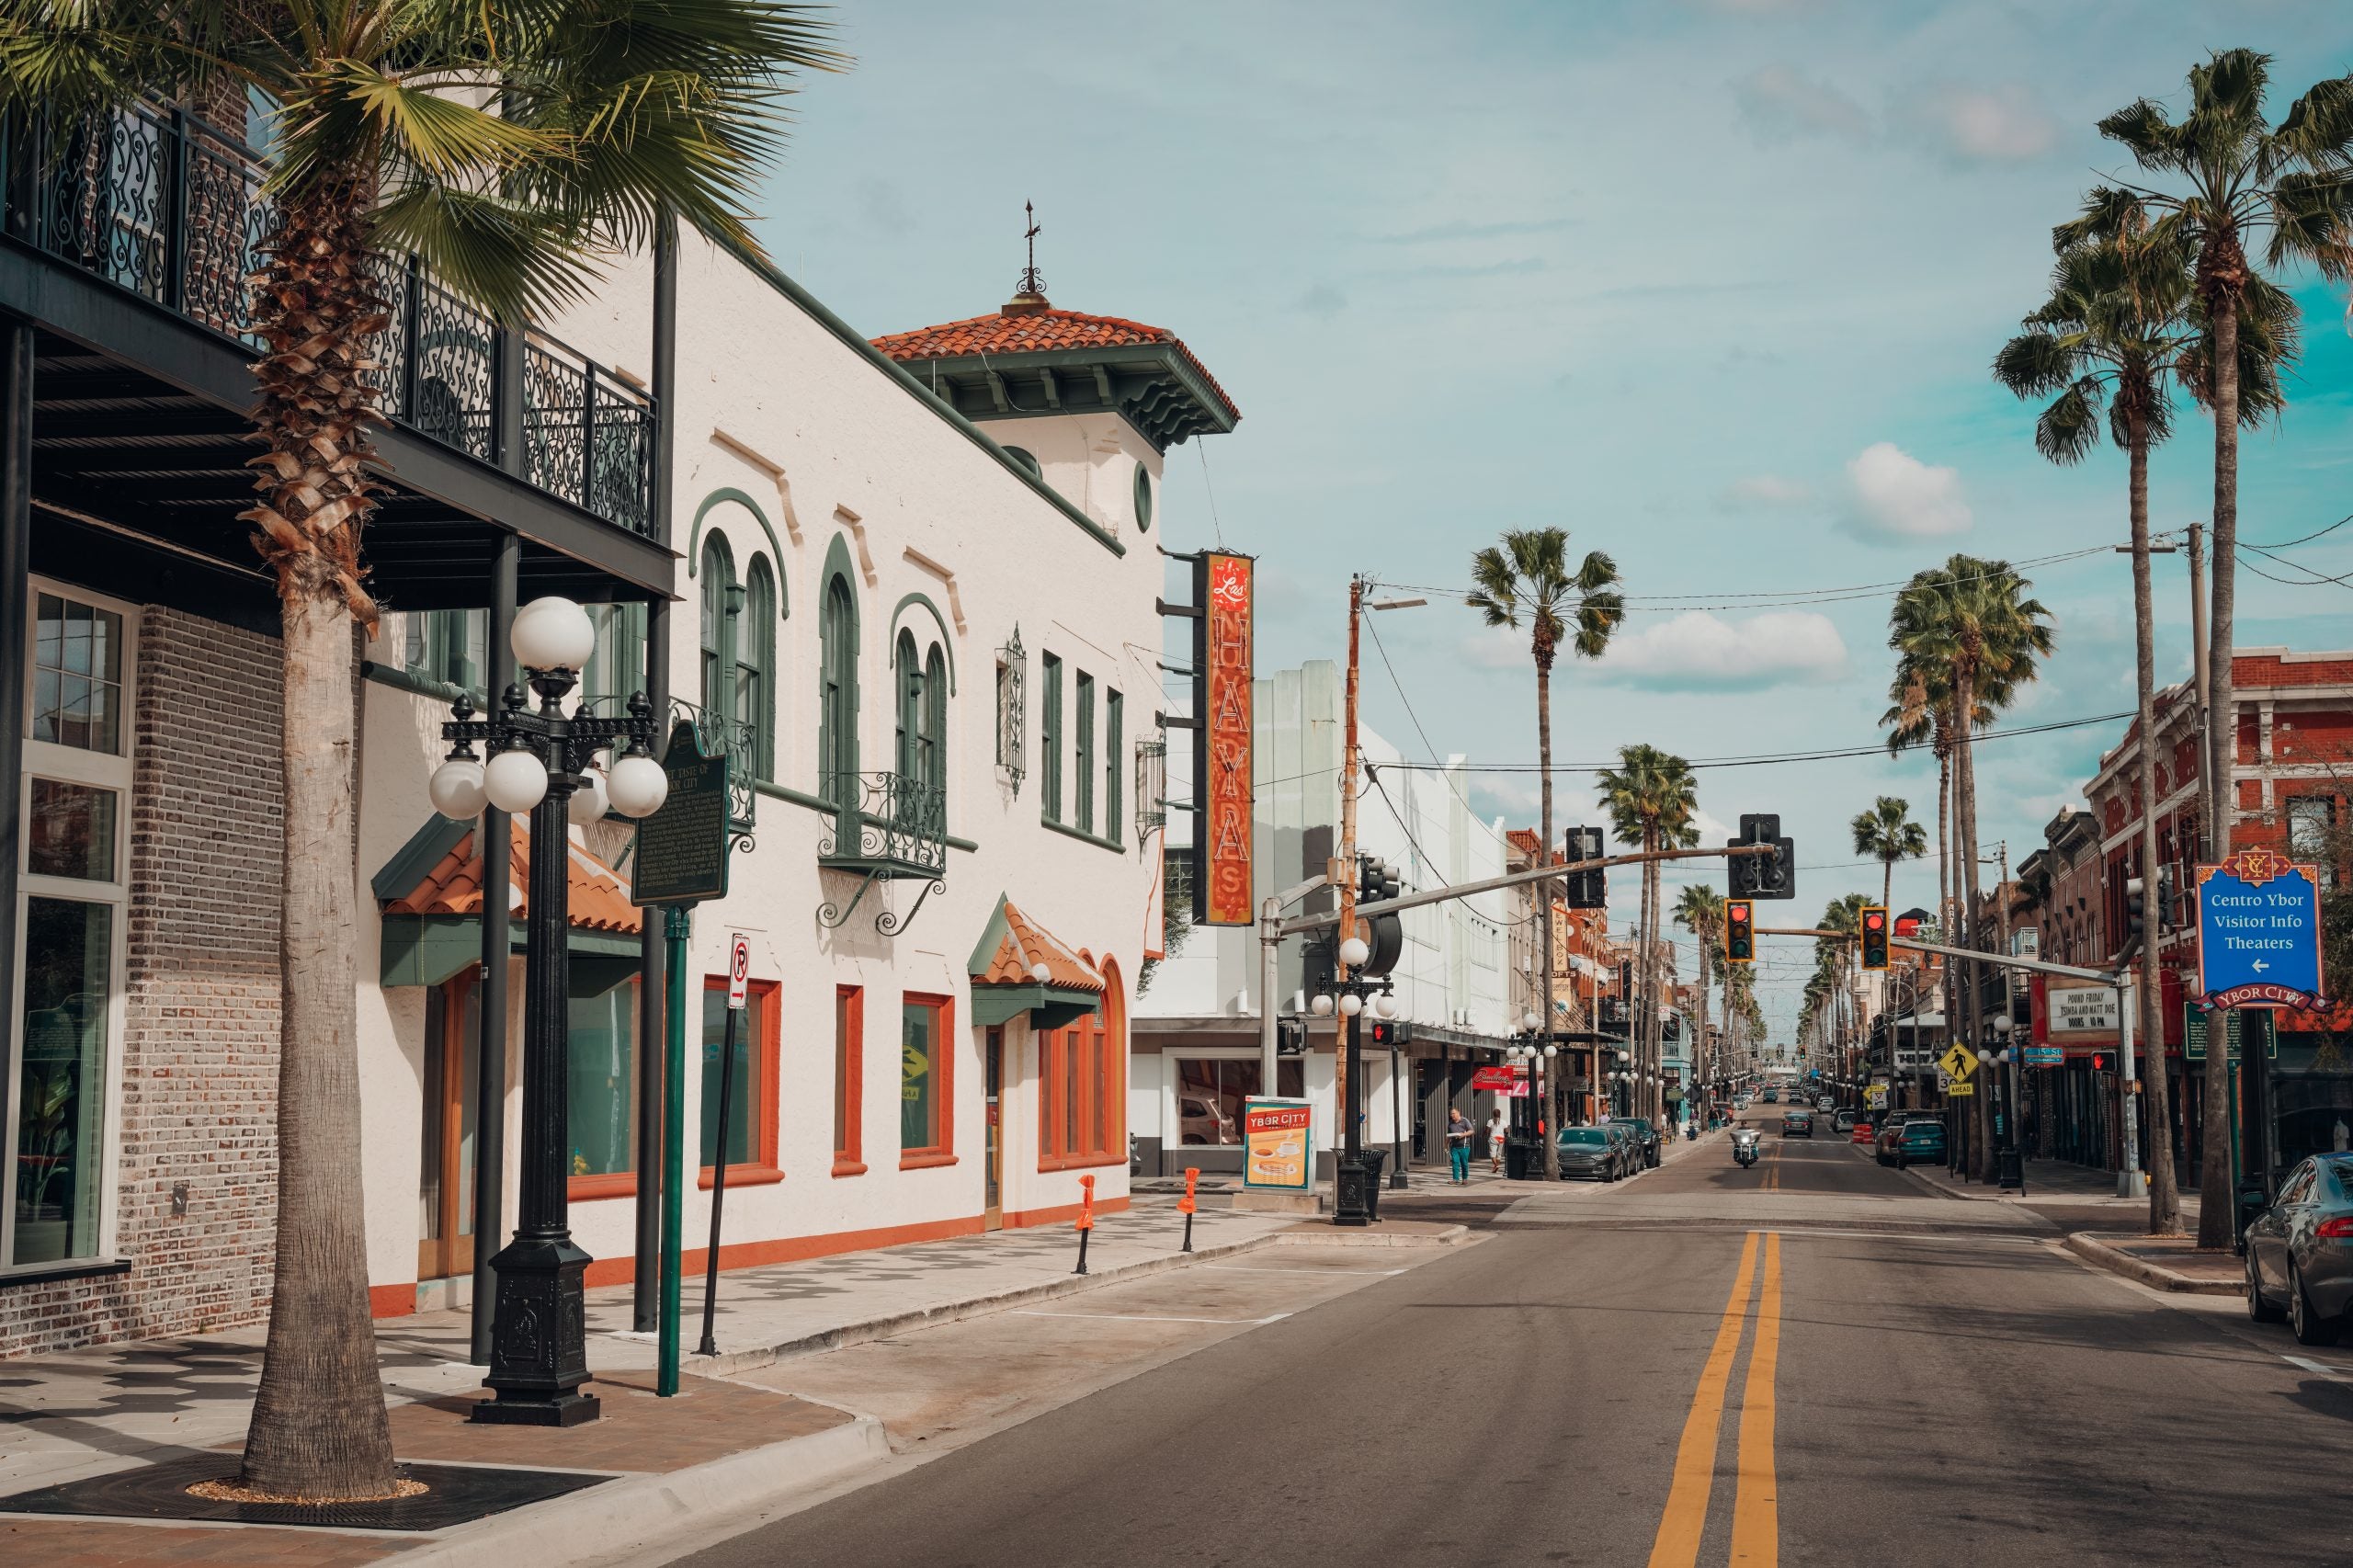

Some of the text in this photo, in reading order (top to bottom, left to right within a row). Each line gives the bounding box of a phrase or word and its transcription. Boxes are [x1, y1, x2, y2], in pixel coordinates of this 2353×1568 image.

[1214, 573, 1247, 603] Las
[2211, 892, 2304, 907] Centro Ybor
[2213, 915, 2302, 928] Visitor Info
[2224, 936, 2293, 950] Theaters
[2067, 992, 2105, 1005] POUND FRIDAY
[2219, 987, 2261, 1006] YBOR
[2078, 1005, 2089, 1017] AND
[2089, 1004, 2103, 1016] MATT
[2105, 1003, 2116, 1014] DOE
[2068, 1017, 2085, 1028] DOORS
[1250, 1113, 1306, 1128] YBOR CITY
